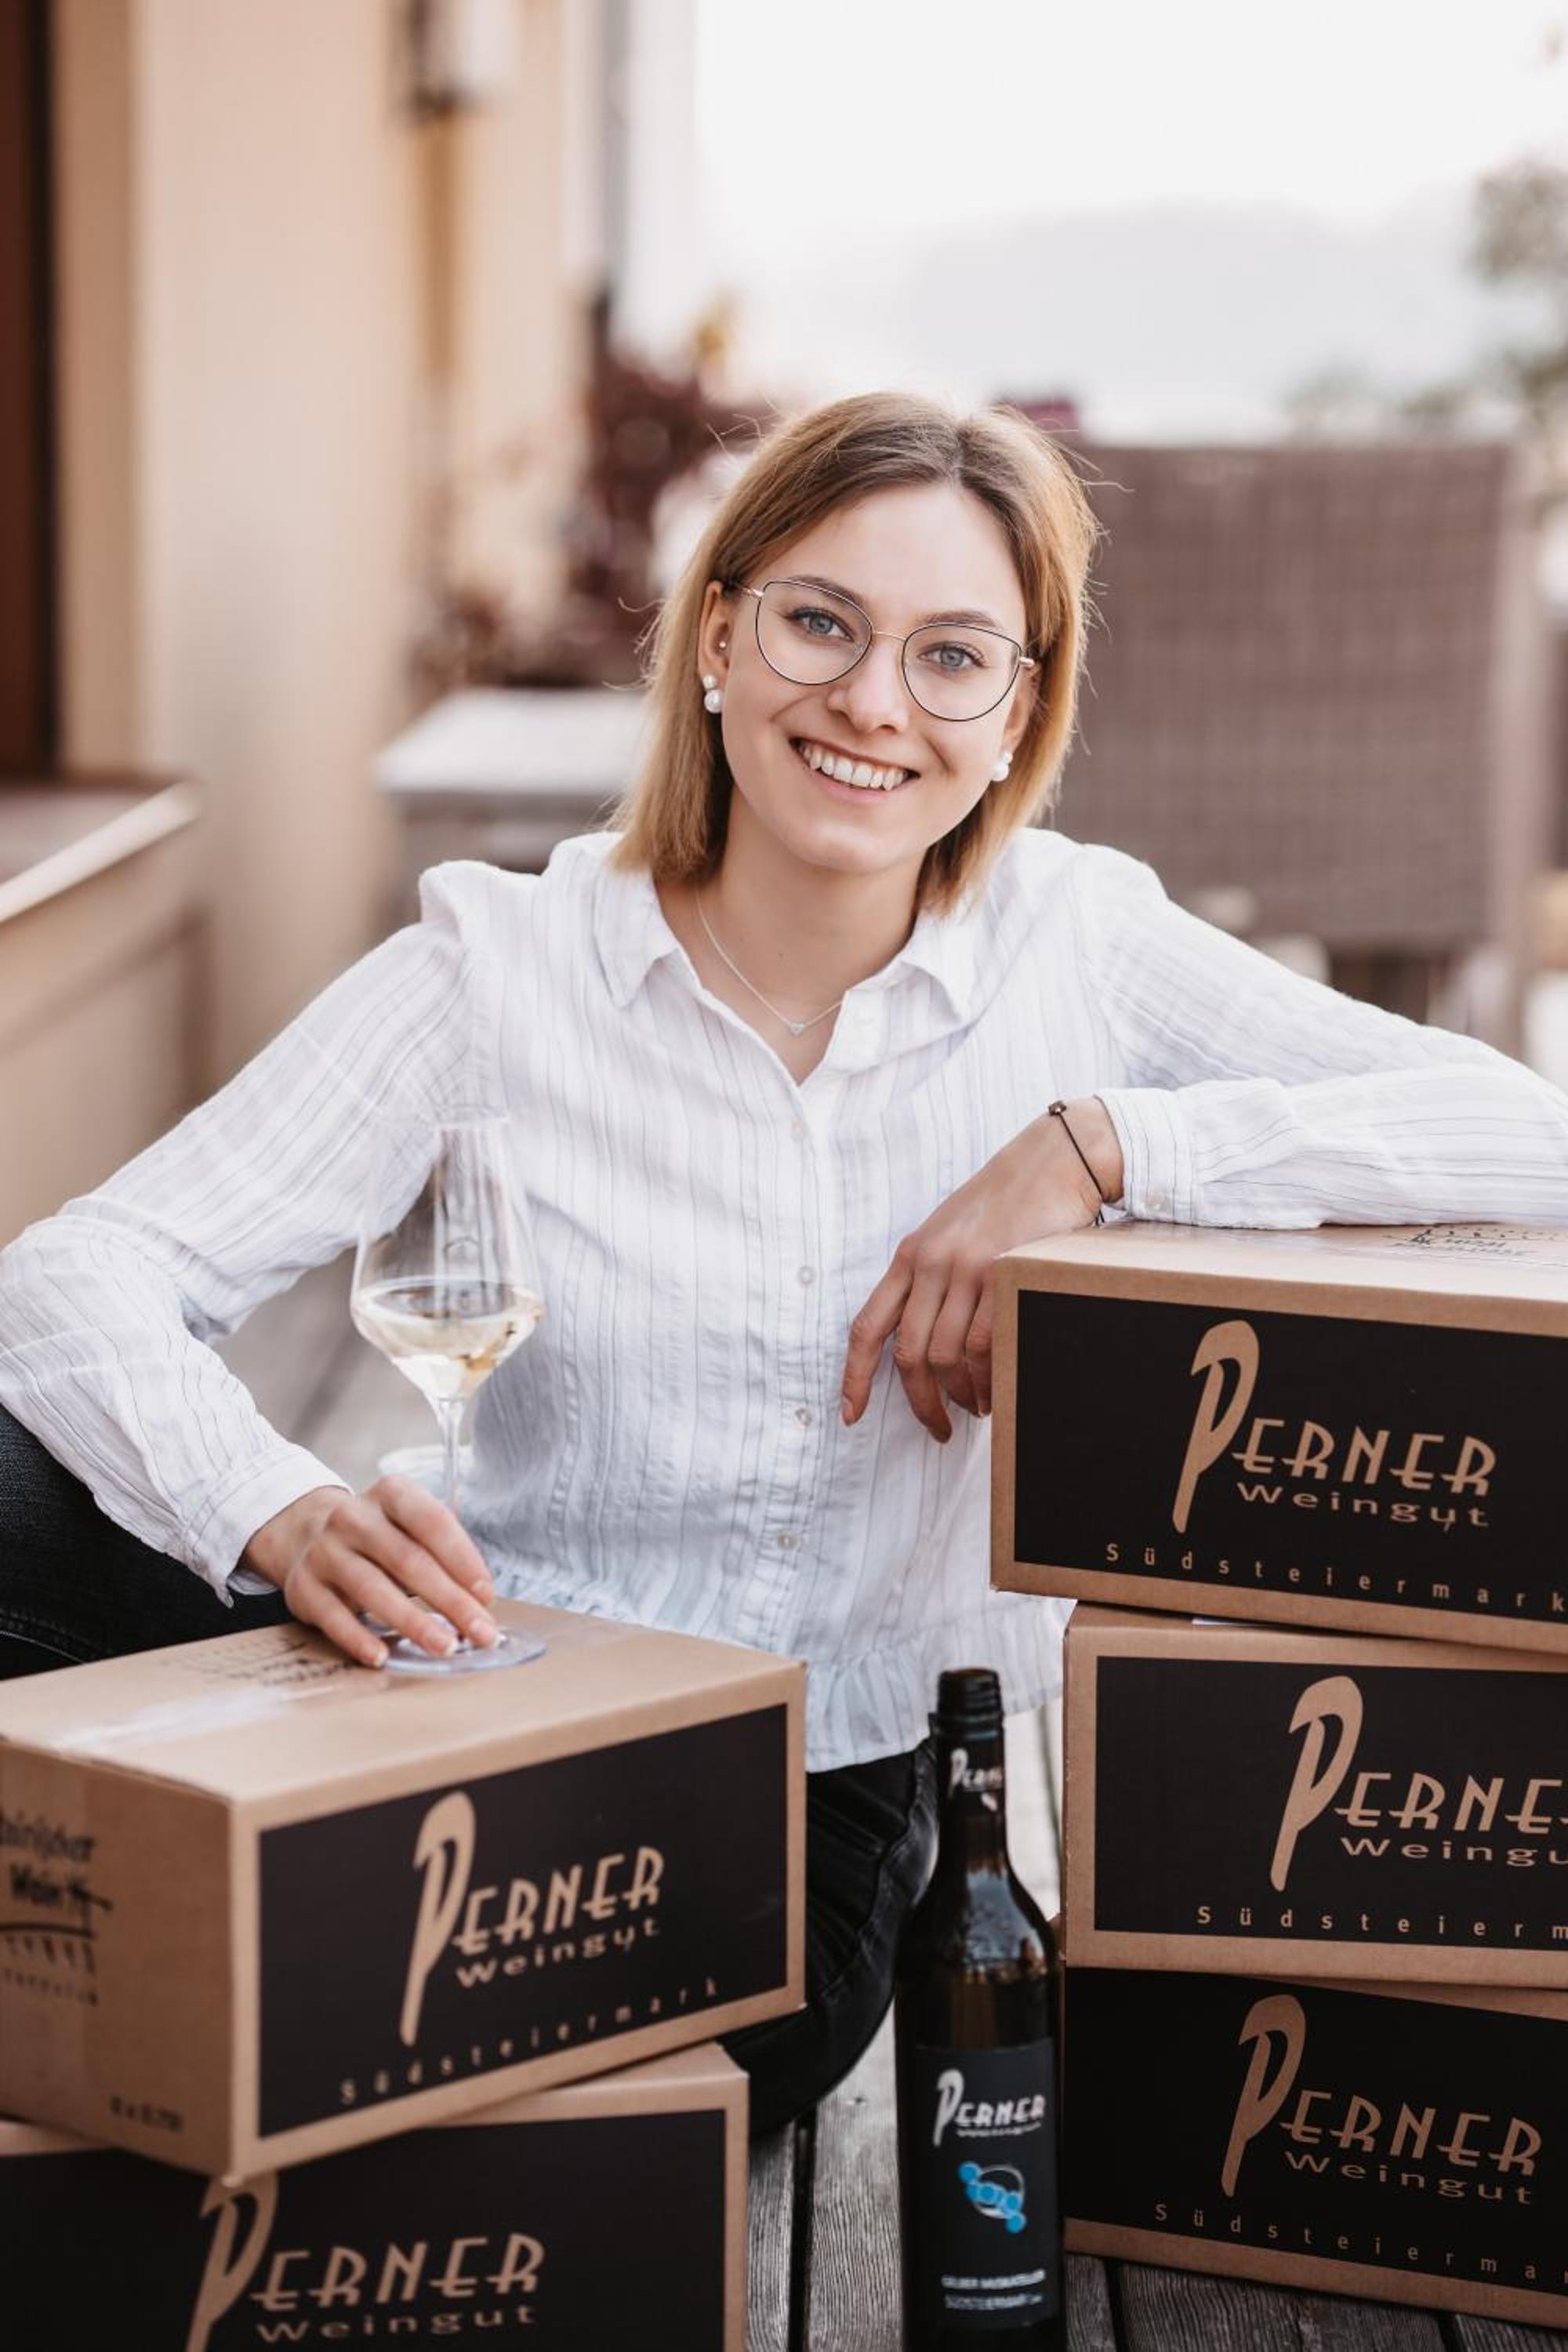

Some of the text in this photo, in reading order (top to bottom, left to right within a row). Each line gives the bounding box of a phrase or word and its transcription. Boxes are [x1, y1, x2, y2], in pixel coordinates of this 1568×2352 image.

[1173, 1320, 1496, 1534] PERNER
[1106, 1543, 1565, 1612] Südsteiermark
[1270, 1675, 1568, 1891] PERNE
[400, 1790, 664, 2045] PERNER
[340, 1977, 717, 2103] Südsteiermark
[1221, 1994, 1542, 2197] PERNER
[934, 2068, 1046, 2147] PERNER
[1285, 2151, 1532, 2205] Weingut
[257, 2305, 535, 2343] Weingut
